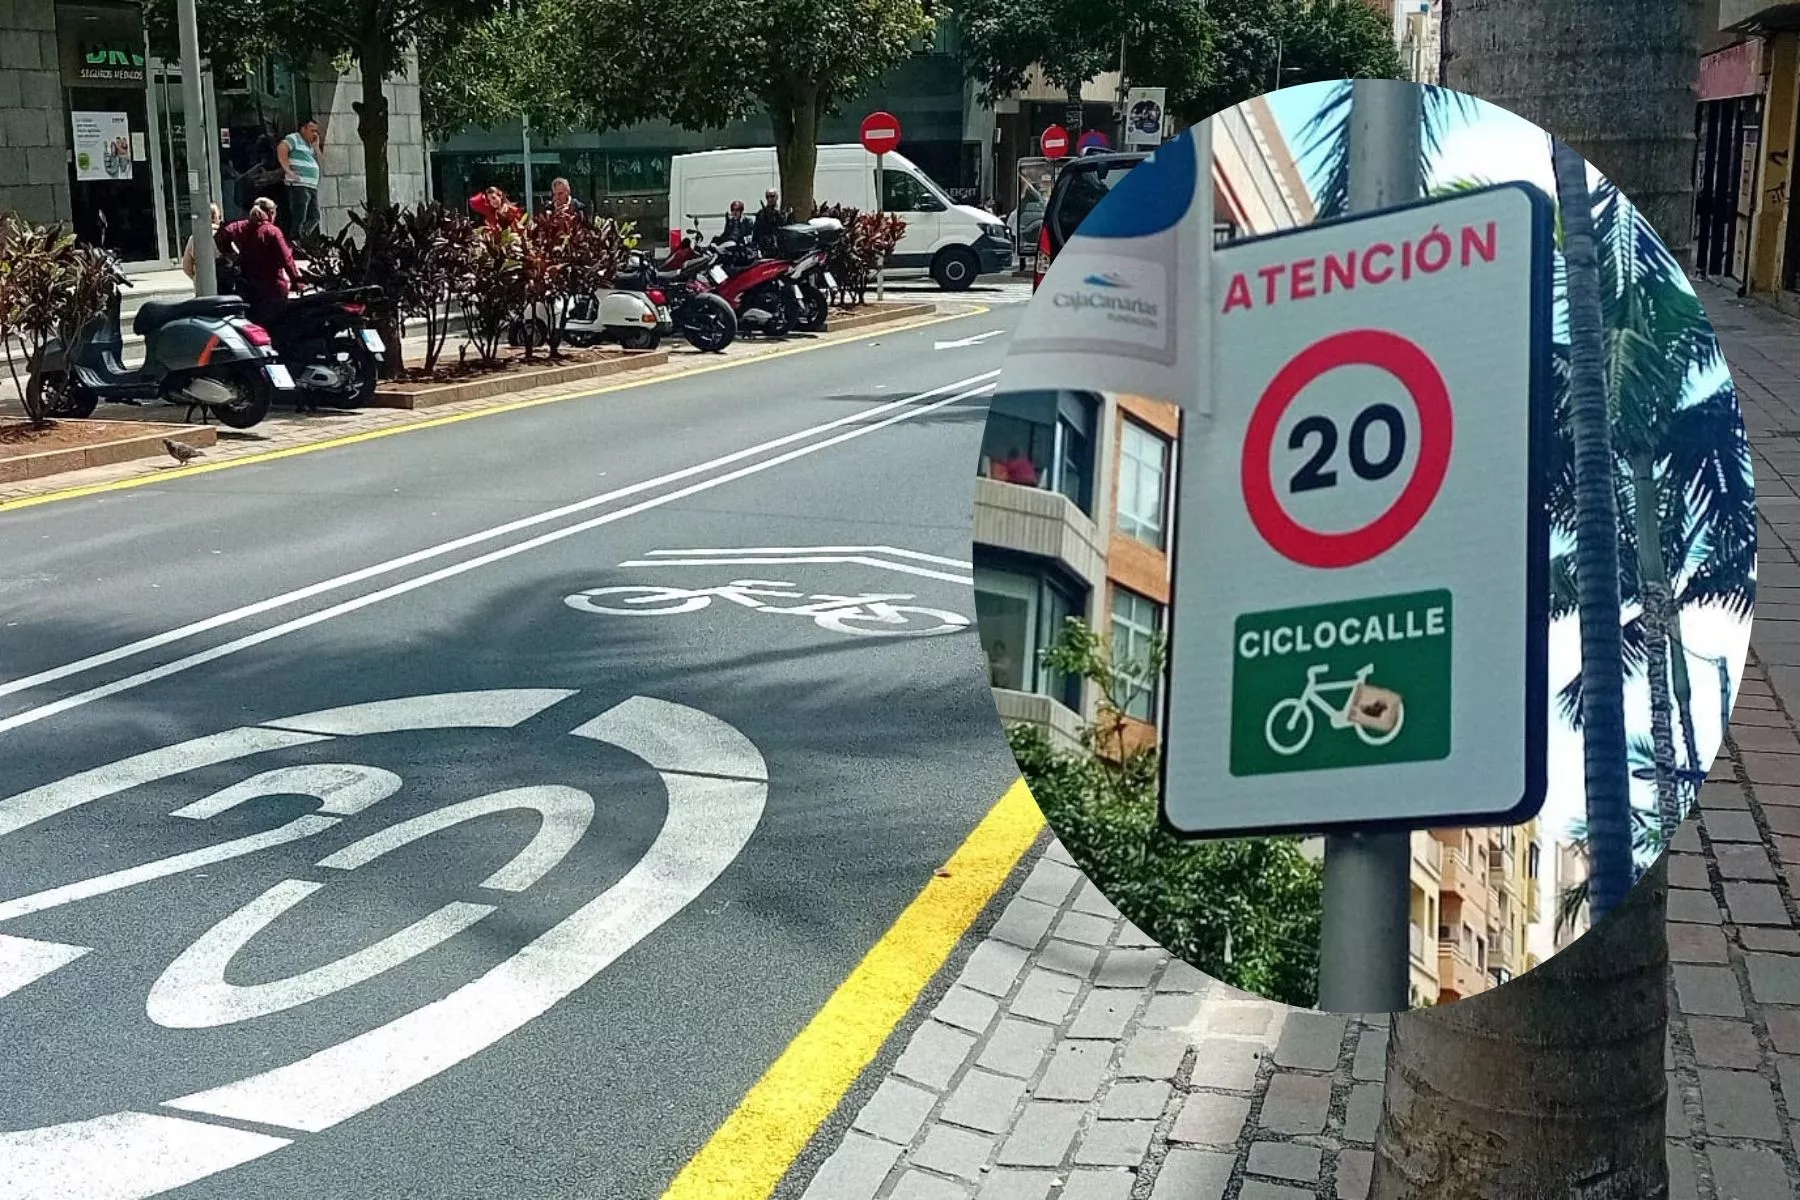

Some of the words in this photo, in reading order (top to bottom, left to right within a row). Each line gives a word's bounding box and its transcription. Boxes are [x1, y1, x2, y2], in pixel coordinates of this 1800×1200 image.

[1221, 221, 1497, 314] ATENCIÓN
[1287, 402, 1407, 494] 20
[1239, 606, 1446, 659] CICLOCALLE
